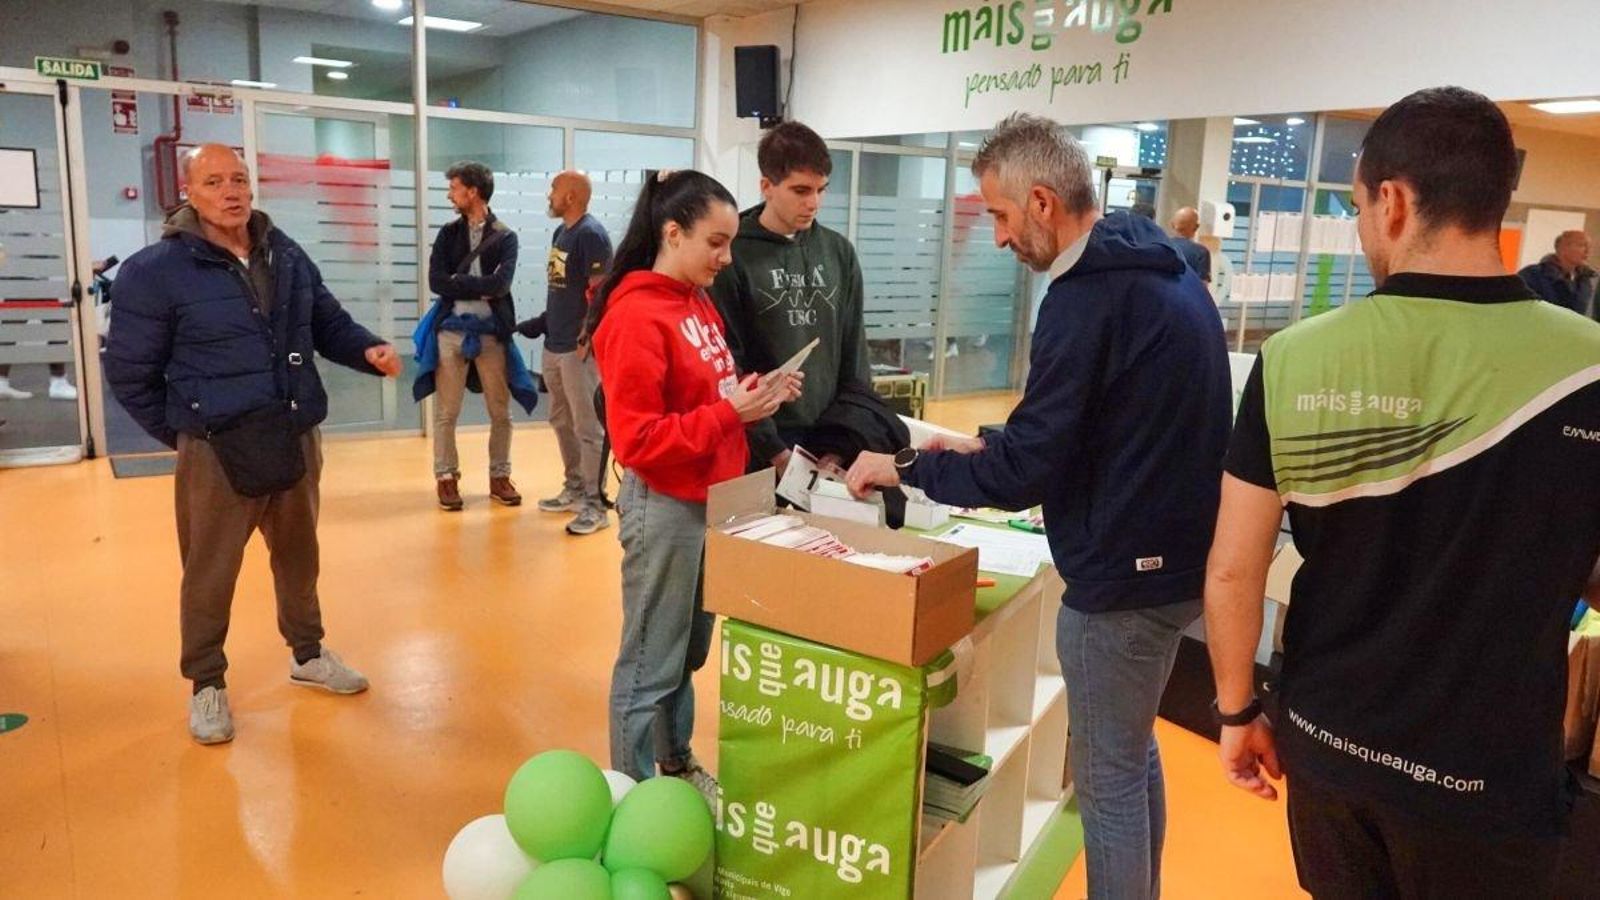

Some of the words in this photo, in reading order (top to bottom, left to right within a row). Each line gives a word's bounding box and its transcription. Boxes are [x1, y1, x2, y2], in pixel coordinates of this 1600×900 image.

[42, 60, 95, 77] SALIDA
[964, 63, 1042, 109] pensado
[1049, 62, 1102, 104] para
[1113, 53, 1130, 84] ti
[786, 310, 817, 326] USC
[1297, 388, 1346, 412] máis
[1367, 394, 1422, 419] auga
[721, 629, 753, 682] is
[758, 642, 788, 697] que
[793, 658, 902, 721] auga
[782, 714, 834, 744] para
[845, 728, 862, 749] ti
[1288, 707, 1485, 792] www.maisqueauga.com
[716, 787, 747, 838] is
[753, 801, 780, 855] que
[785, 820, 891, 883] auga
